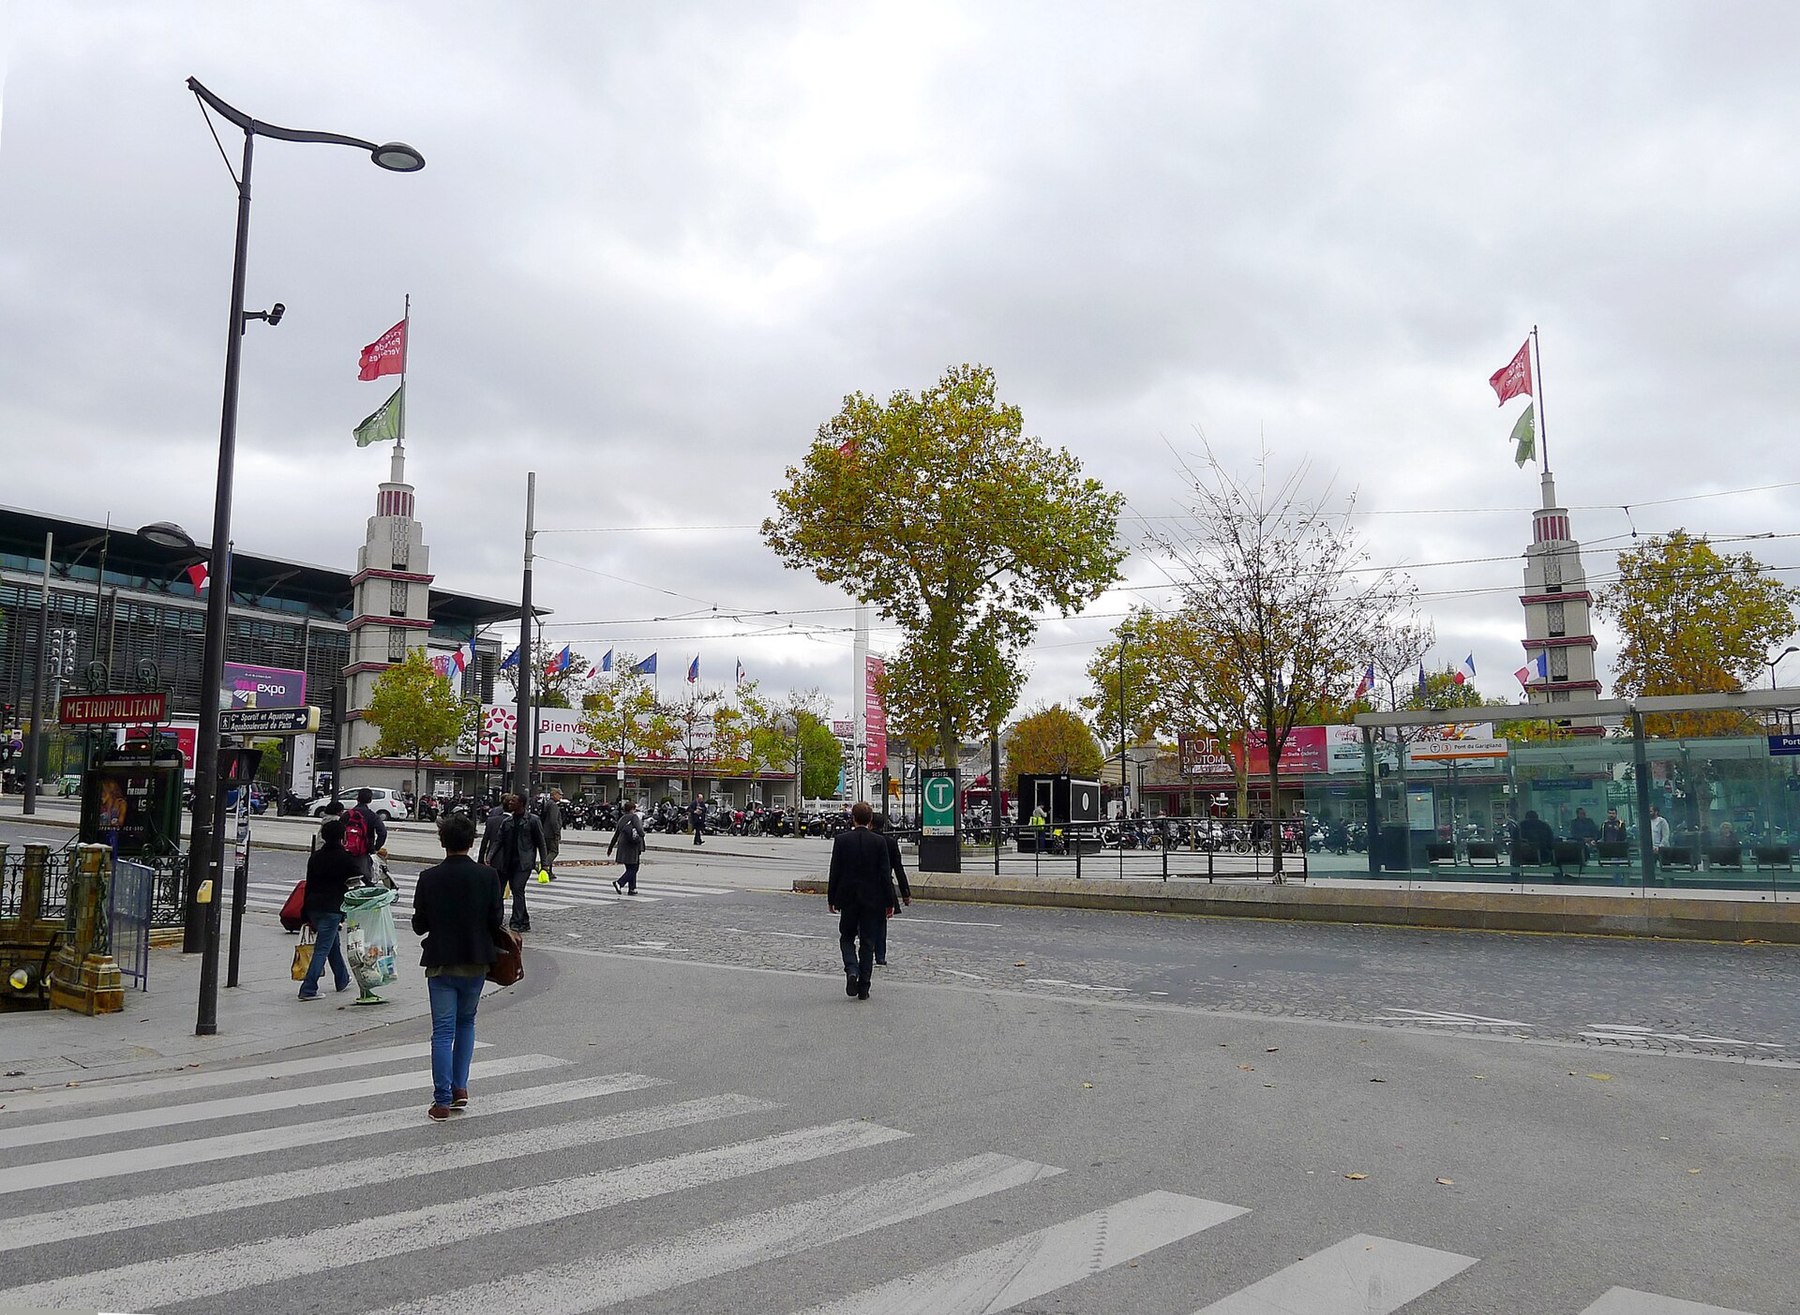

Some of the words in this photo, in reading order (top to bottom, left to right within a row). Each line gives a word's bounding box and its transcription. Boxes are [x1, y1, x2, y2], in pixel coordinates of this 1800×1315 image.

[66, 699, 161, 718] METROPOLITAIN
[240, 712, 260, 723] Sportif
[261, 713, 267, 721] et
[267, 711, 296, 723] Aquatique
[230, 720, 269, 732] Aquaboulevard
[269, 720, 277, 730] de
[277, 720, 292, 729] Paris
[541, 719, 587, 734] Bienve
[1184, 737, 1224, 755] FOIR
[1782, 738, 1800, 746] Port
[904, 763, 916, 778] 7
[932, 783, 949, 805] T
